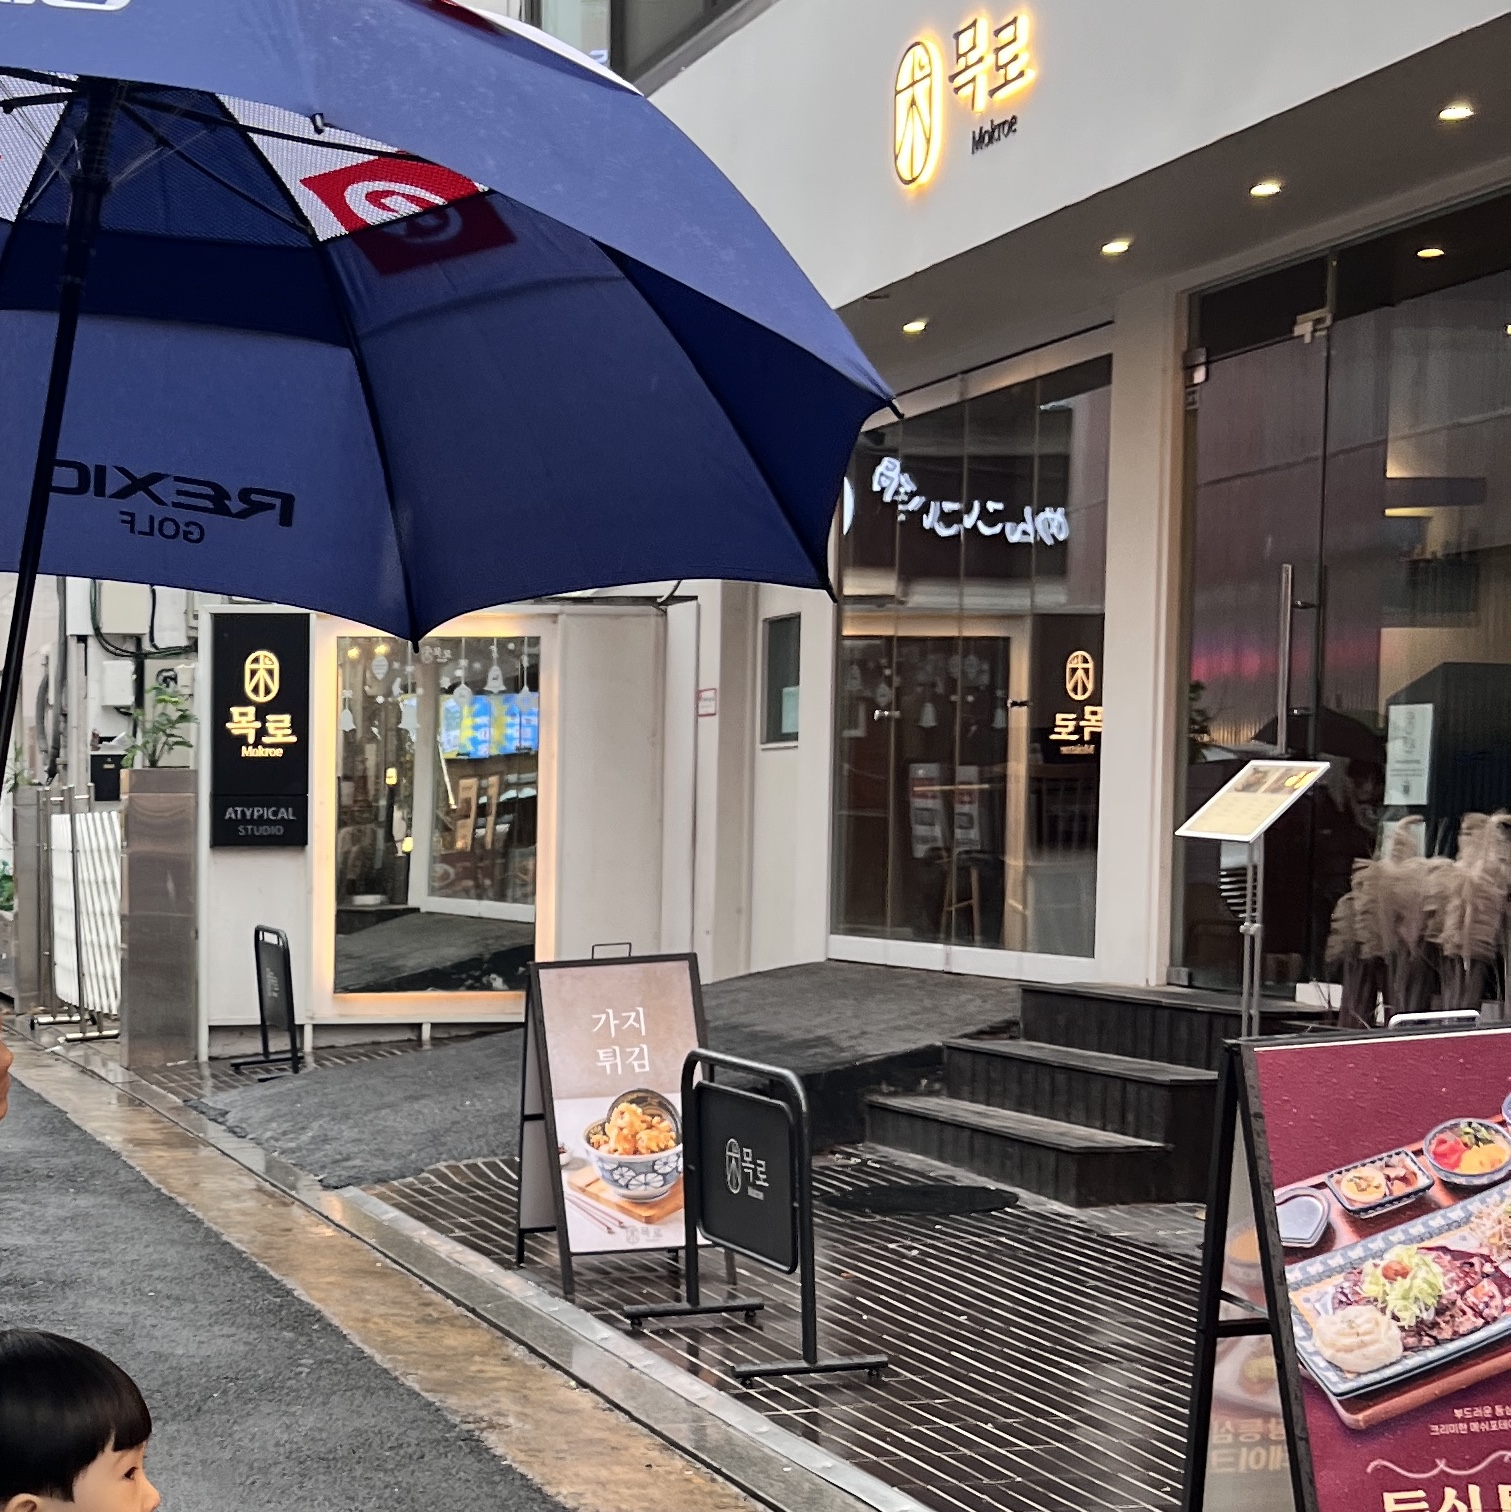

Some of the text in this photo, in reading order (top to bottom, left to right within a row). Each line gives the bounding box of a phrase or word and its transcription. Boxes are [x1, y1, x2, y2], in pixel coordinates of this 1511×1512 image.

[948, 16, 1035, 112] 목로
[225, 705, 298, 745] 목로
[224, 806, 298, 821] ATYPICAL
[238, 824, 285, 837] STUDIO
[591, 1006, 646, 1038] 가지
[595, 1043, 650, 1076] 튀김
[741, 1147, 769, 1188] 목로
